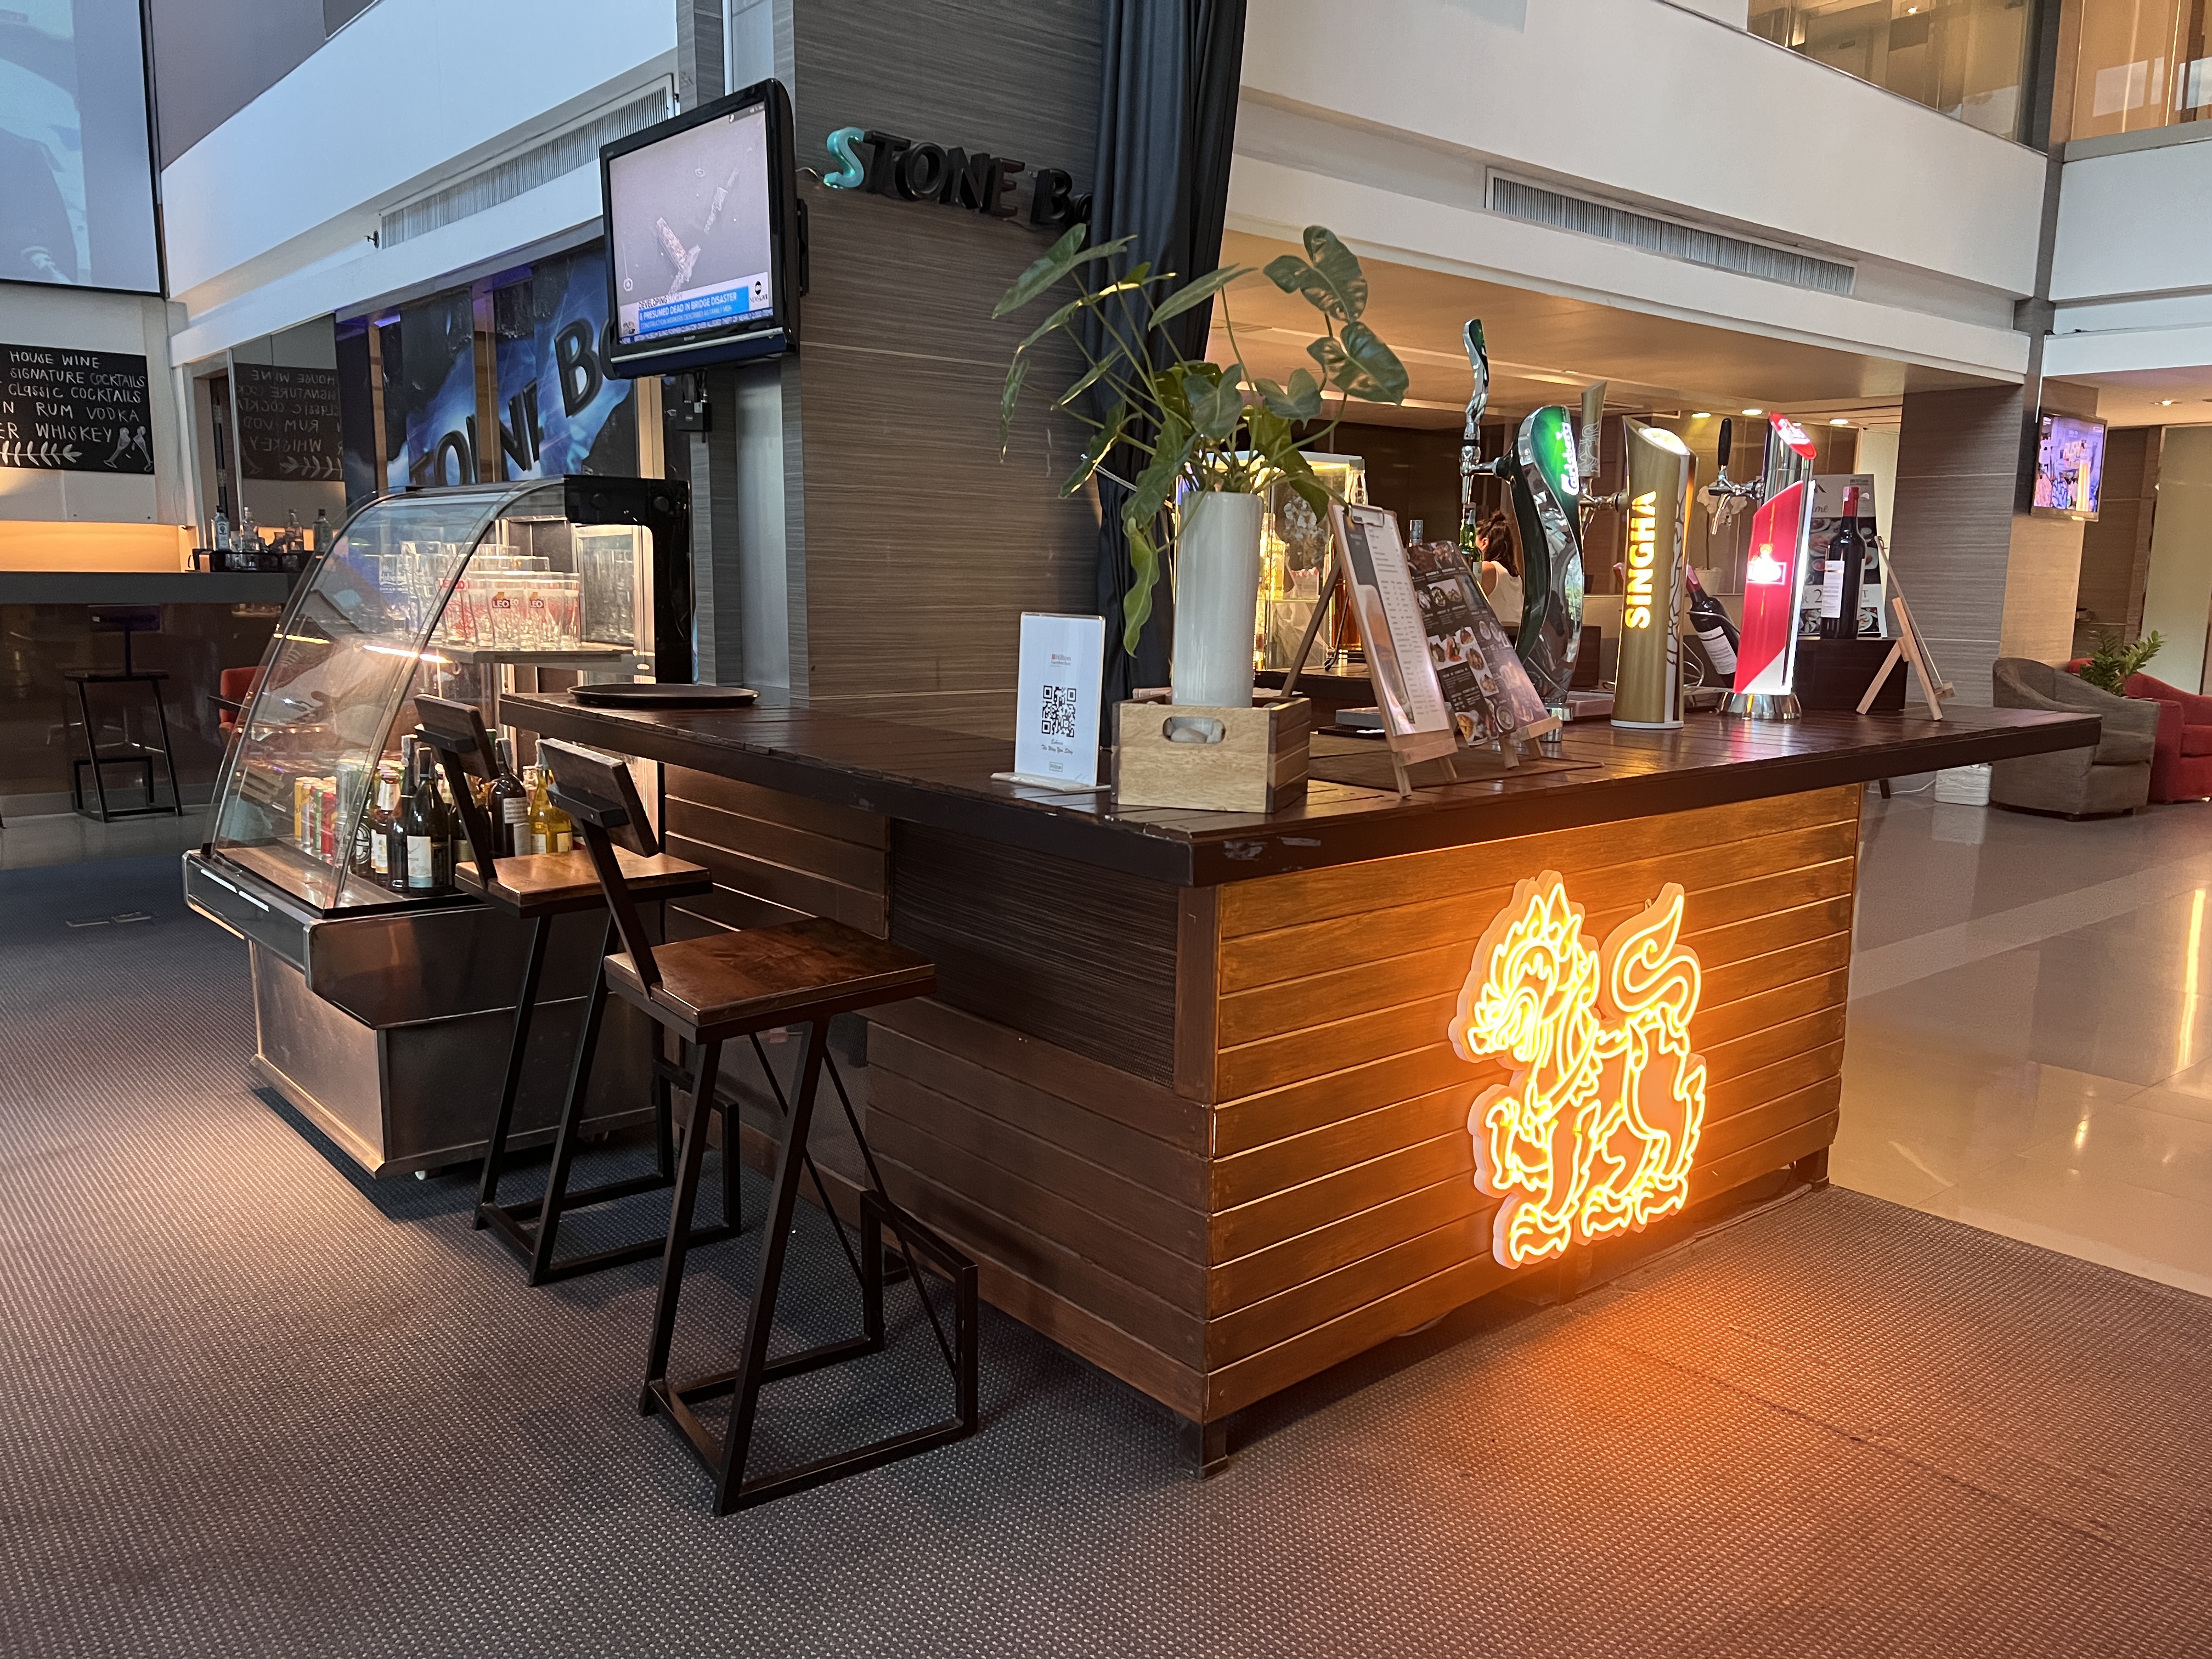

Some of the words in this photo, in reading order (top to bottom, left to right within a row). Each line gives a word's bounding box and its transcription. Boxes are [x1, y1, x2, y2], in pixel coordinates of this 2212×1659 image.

[823, 126, 1025, 218] STONE
[644, 307, 669, 320] PRESUMED
[670, 303, 684, 315] DEAD
[684, 302, 691, 311] IN
[691, 297, 710, 310] BRIDGE
[710, 292, 737, 306] DISASTER
[9, 351, 54, 364] HOUSE
[62, 354, 100, 369] WINE
[10, 368, 84, 383] SIGNATURE
[90, 373, 145, 388] COCKTAILS
[71, 387, 141, 403] COCKTAILS
[36, 402, 73, 419] RUM
[86, 407, 140, 422] VODKA
[35, 423, 111, 442] WHISKEY
[1625, 490, 1656, 629] SINGHA
[492, 600, 510, 608] LEO
